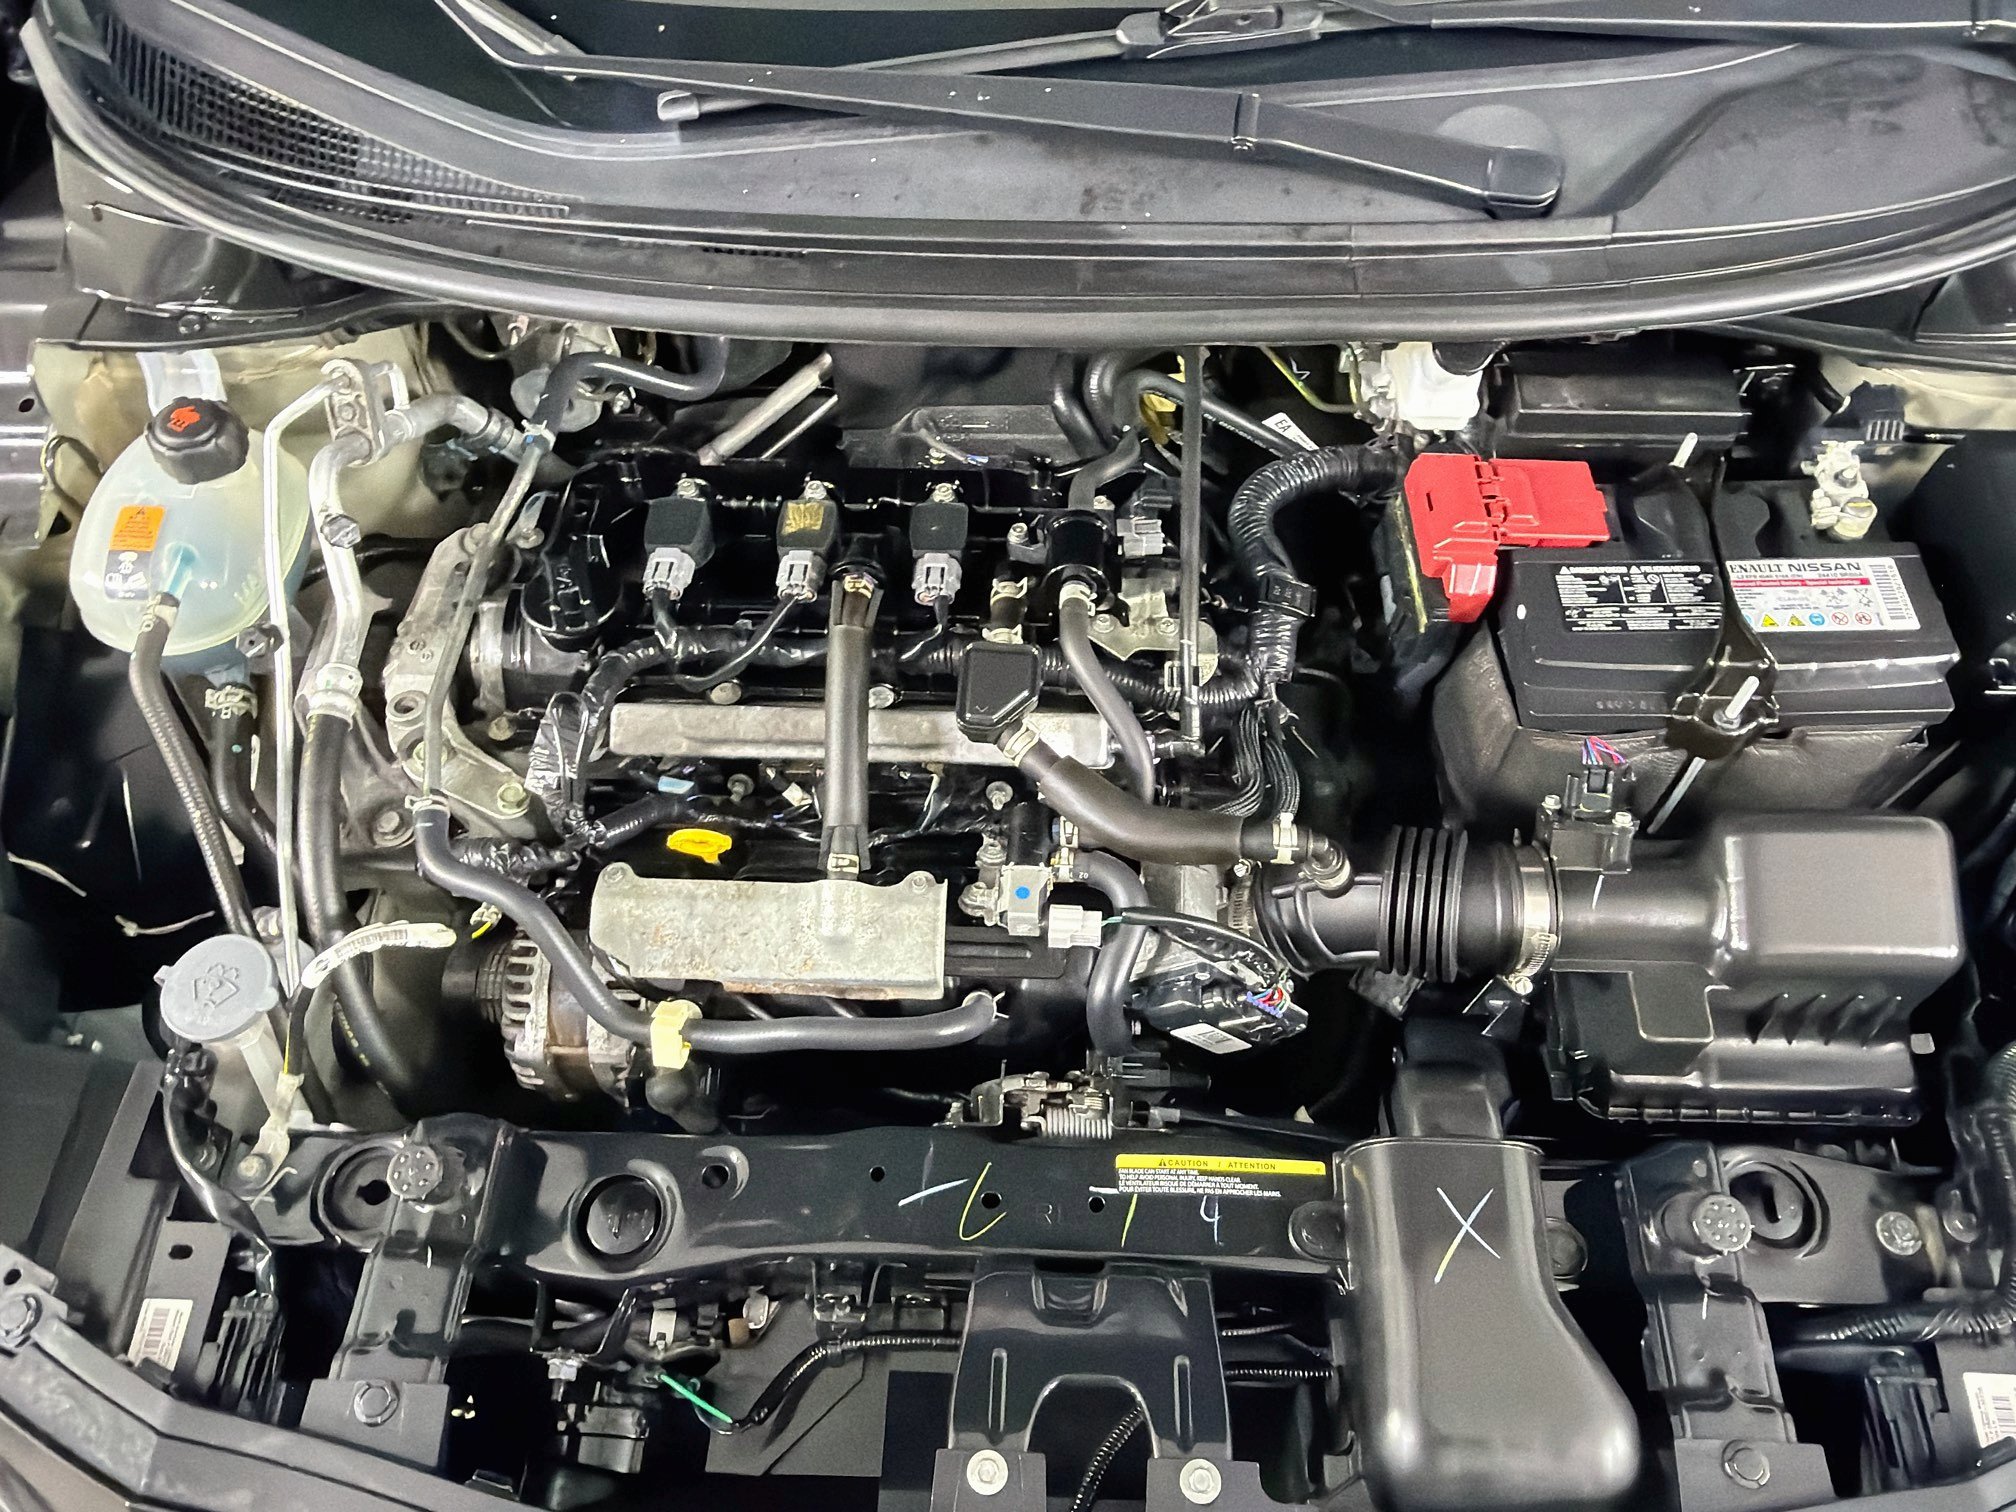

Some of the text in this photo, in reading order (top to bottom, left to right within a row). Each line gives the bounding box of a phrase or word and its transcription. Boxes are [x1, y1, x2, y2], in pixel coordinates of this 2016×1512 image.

[1729, 562, 1861, 573] ENAULT NISSAN
[1168, 1159, 1209, 1167] CAUTION
[1228, 1161, 1276, 1170] ATTENTION
